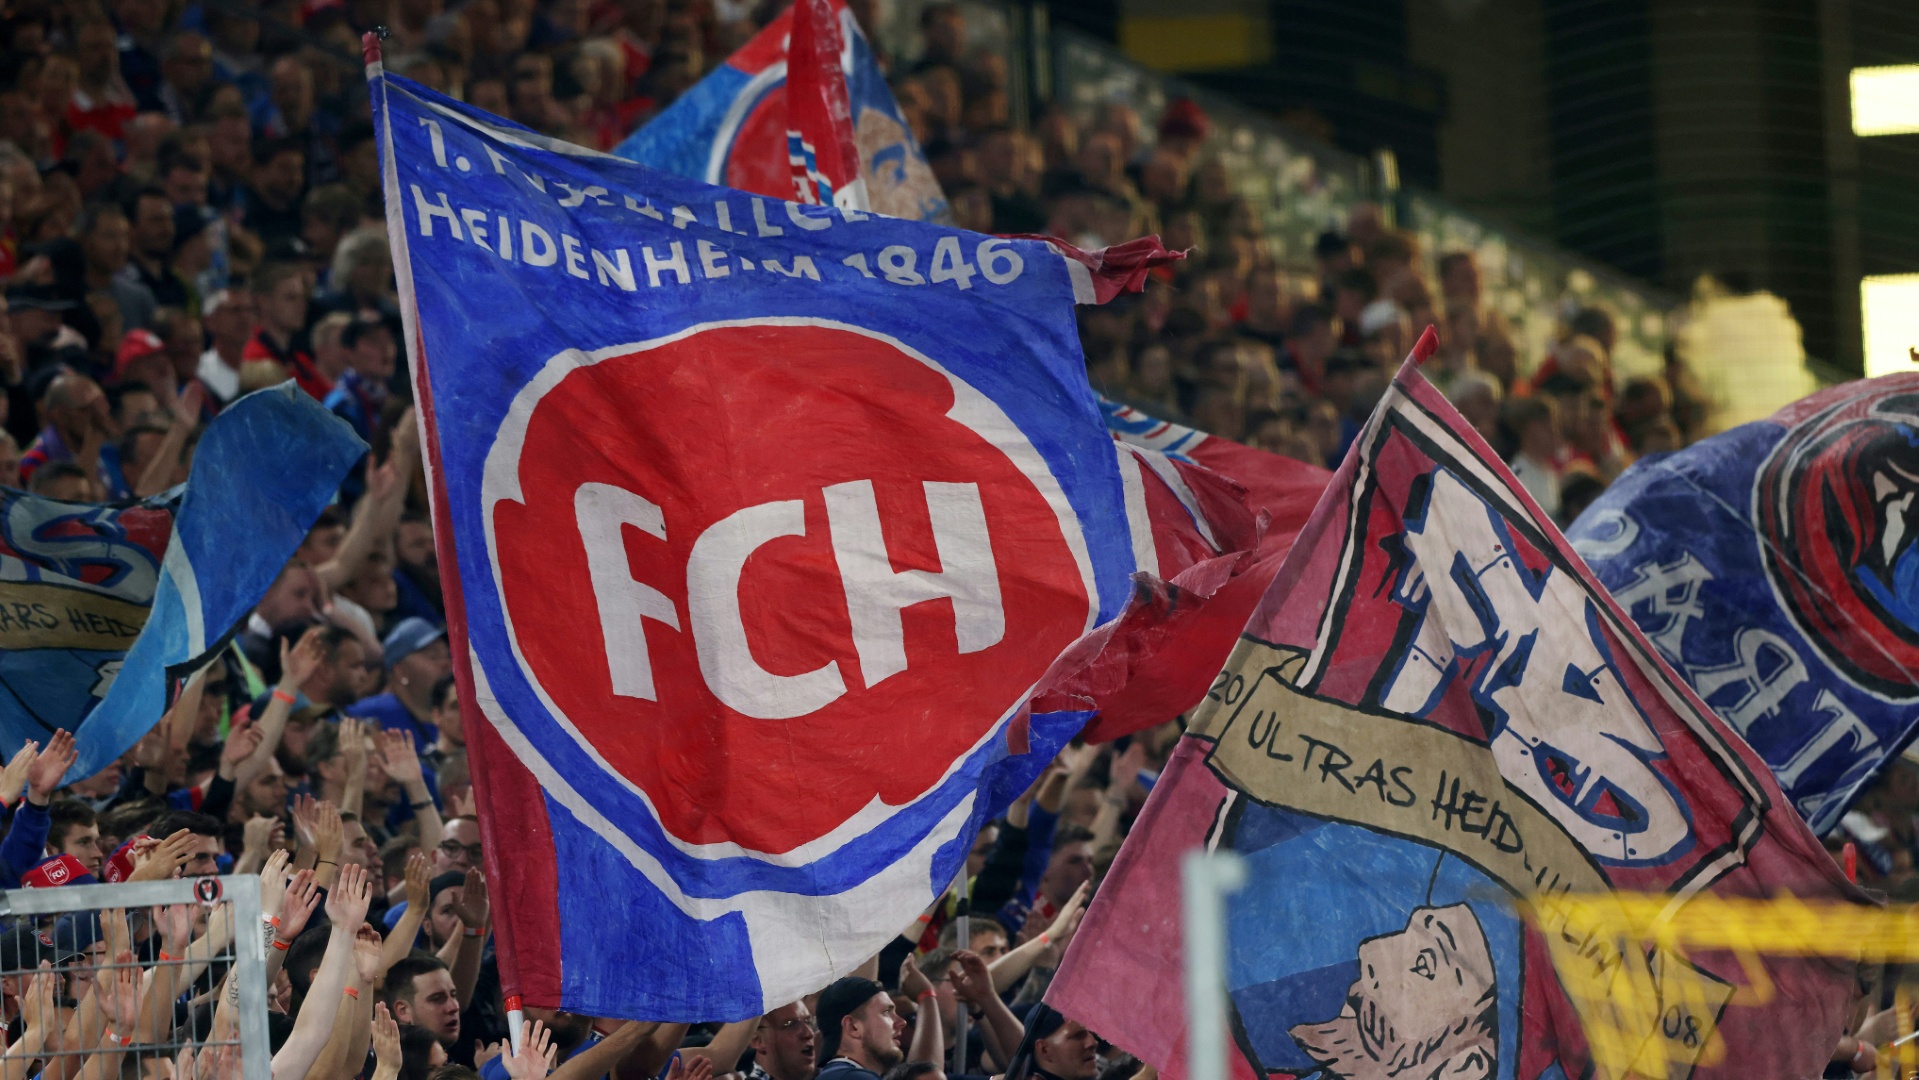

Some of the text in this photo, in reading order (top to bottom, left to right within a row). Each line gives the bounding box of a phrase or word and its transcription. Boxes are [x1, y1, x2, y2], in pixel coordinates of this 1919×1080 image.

[418, 118, 471, 172] 1.
[410, 184, 1023, 293] HEIDENHEM 1846
[573, 478, 1005, 719] FCH
[1207, 670, 1244, 705] 20
[1248, 710, 1417, 808] ULTRAS
[1663, 1004, 1703, 1049] 08
